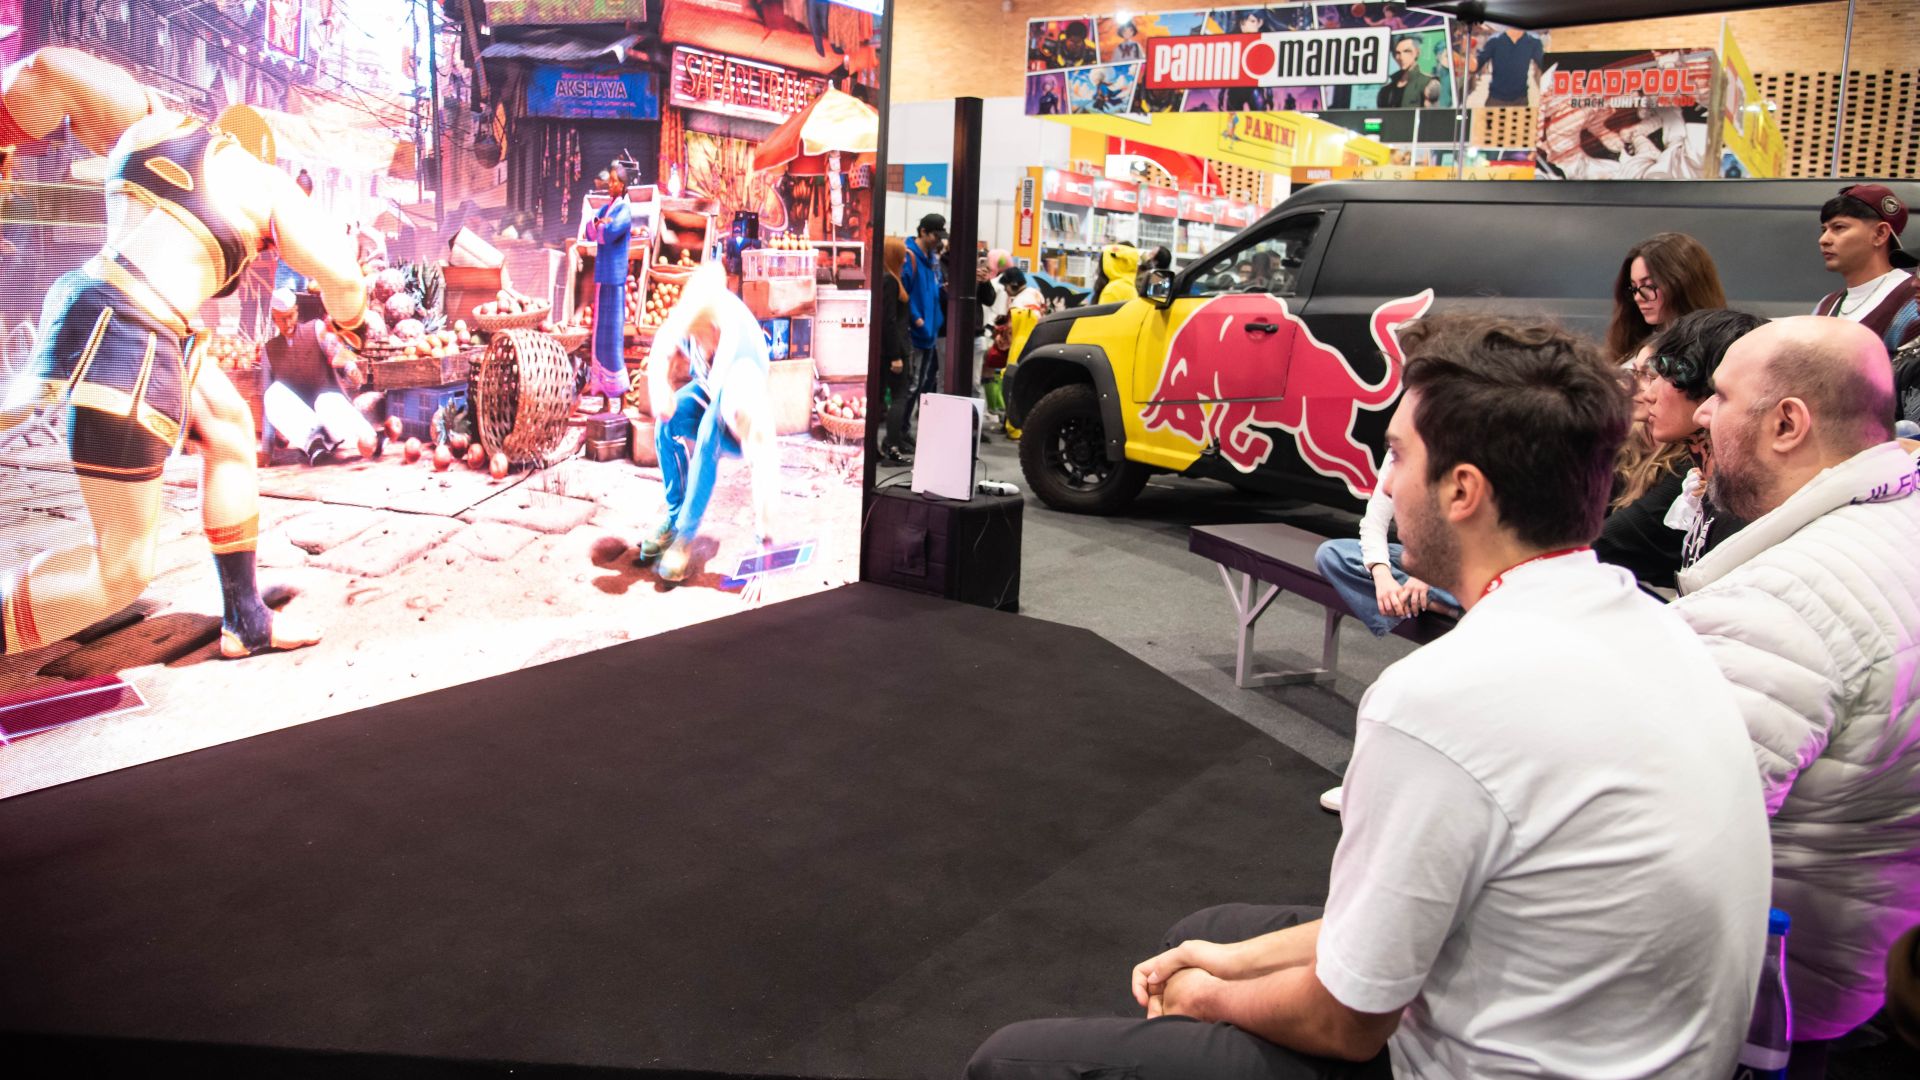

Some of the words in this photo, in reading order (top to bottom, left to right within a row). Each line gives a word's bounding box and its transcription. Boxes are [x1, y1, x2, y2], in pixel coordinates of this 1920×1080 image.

[555, 80, 628, 99] AKSHAYA
[683, 54, 751, 105] SAFARI
[758, 69, 816, 113] TRAVE
[1553, 69, 1697, 96] DEADPOOL
[1571, 97, 1604, 108] BLACK
[1610, 96, 1648, 108] WHITE
[1244, 115, 1296, 148] PANINI
